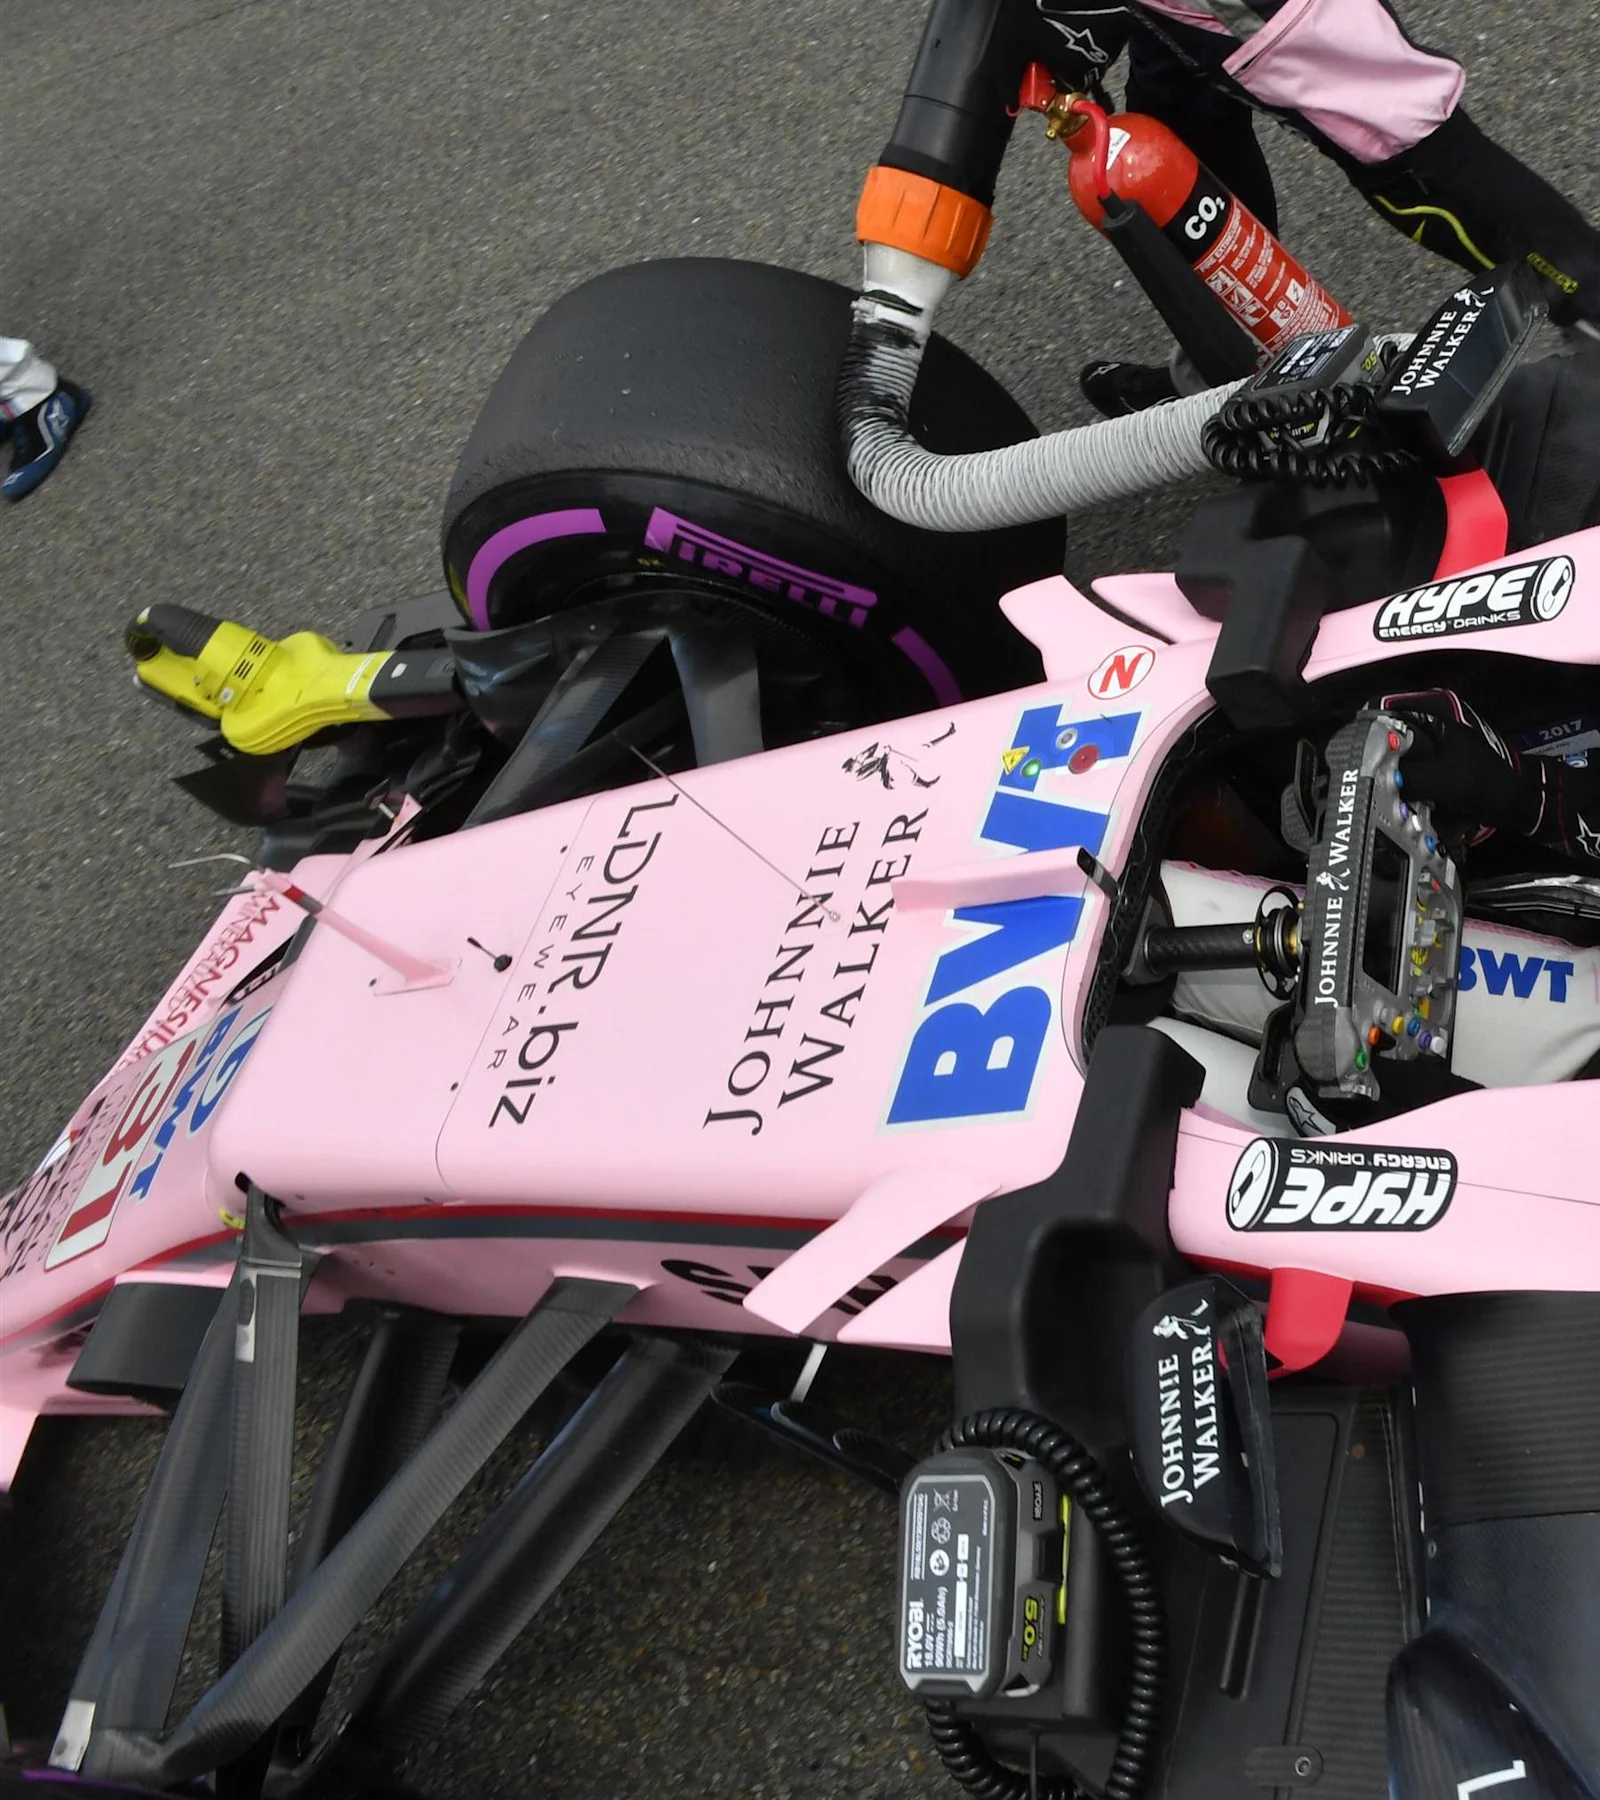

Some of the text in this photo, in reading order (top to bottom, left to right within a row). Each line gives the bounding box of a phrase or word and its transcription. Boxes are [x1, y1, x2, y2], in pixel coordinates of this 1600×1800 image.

[1391, 310, 1457, 395] JOHNNIE
[1414, 307, 1483, 390] WALKER
[644, 506, 878, 630] PIRELLI
[1380, 564, 1537, 629] HYPE
[1099, 653, 1146, 693] N
[1378, 608, 1522, 639] ENERGY DRINKS
[1538, 718, 1582, 742] 2017
[886, 703, 1148, 1125] BWT
[1315, 768, 1360, 1010] JOHNNIE WALKER
[137, 897, 280, 1060] MAGNESIU
[487, 855, 595, 1071] EYEWEAR
[488, 793, 680, 1129] LDNR.biz
[703, 820, 860, 1137] JOHNNIE
[778, 807, 929, 1110] WALKER
[1457, 946, 1574, 1003] BWT
[1267, 1173, 1453, 1225] HYPE
[1290, 1148, 1452, 1170] ENERGY DRINKS
[1157, 1353, 1194, 1508] JOHNNIE
[1191, 1340, 1219, 1490] WALKER
[906, 1599, 924, 1669] RYOBI
